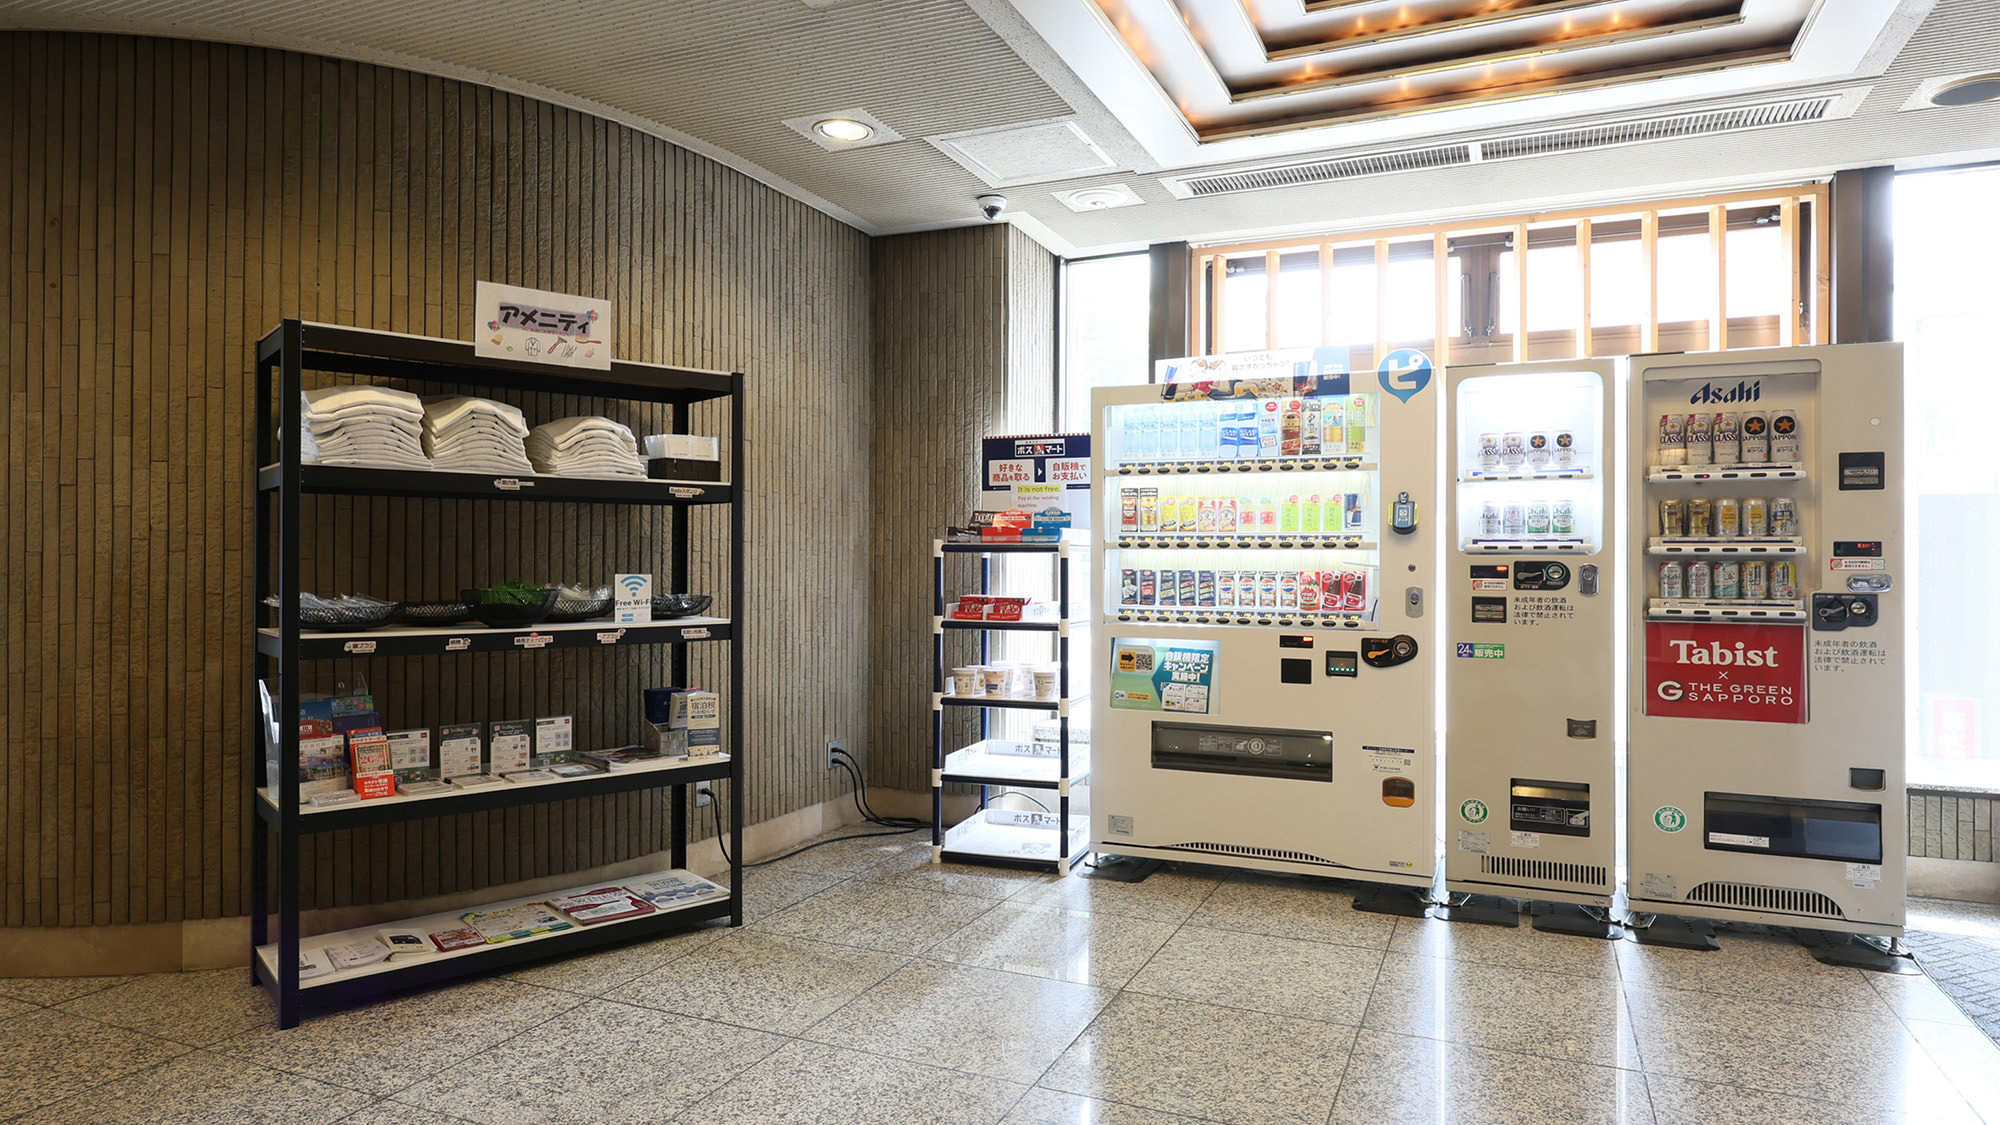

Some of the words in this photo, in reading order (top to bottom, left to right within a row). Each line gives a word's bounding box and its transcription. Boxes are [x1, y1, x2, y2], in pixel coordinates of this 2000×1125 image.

[500, 305, 589, 334] アメニティ
[1690, 380, 1760, 405] Asahi
[999, 463, 1023, 472] 好きな
[1053, 461, 1087, 471] 自販機で
[992, 473, 1030, 482] 商品を取る
[1052, 472, 1088, 481] お支払い
[1032, 485, 1043, 493] not
[1814, 640, 1877, 648] 未成年者の飲酒
[1475, 649, 1503, 658] 販売中
[1669, 640, 1779, 667] Tabist
[1815, 648, 1886, 656] および飲酒運転は
[1165, 651, 1210, 663] 自販機限定
[1814, 656, 1886, 665] 法律で禁止されて
[1163, 661, 1209, 673] キャンペーン
[1815, 664, 1845, 672] います。
[1688, 682, 1722, 692] THE
[1730, 684, 1792, 695] GREEN
[1688, 692, 1793, 705] SAPPORO
[691, 701, 716, 709] 宿泊税
